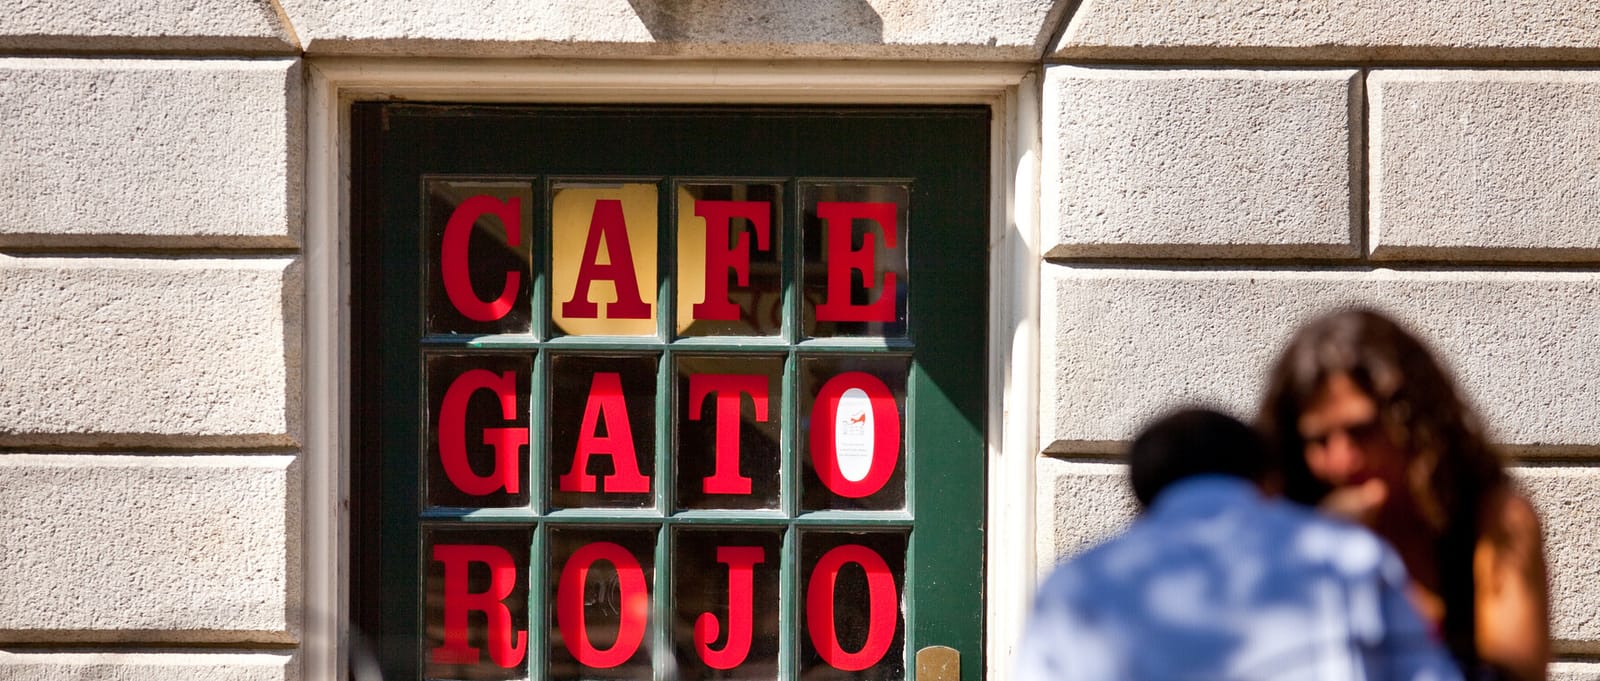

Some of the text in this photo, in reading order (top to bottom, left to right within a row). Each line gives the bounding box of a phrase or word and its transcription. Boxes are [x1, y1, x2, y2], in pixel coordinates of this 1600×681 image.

[441, 193, 898, 323] CAFE
[437, 368, 902, 499] GATO
[431, 541, 900, 673] ROJO
